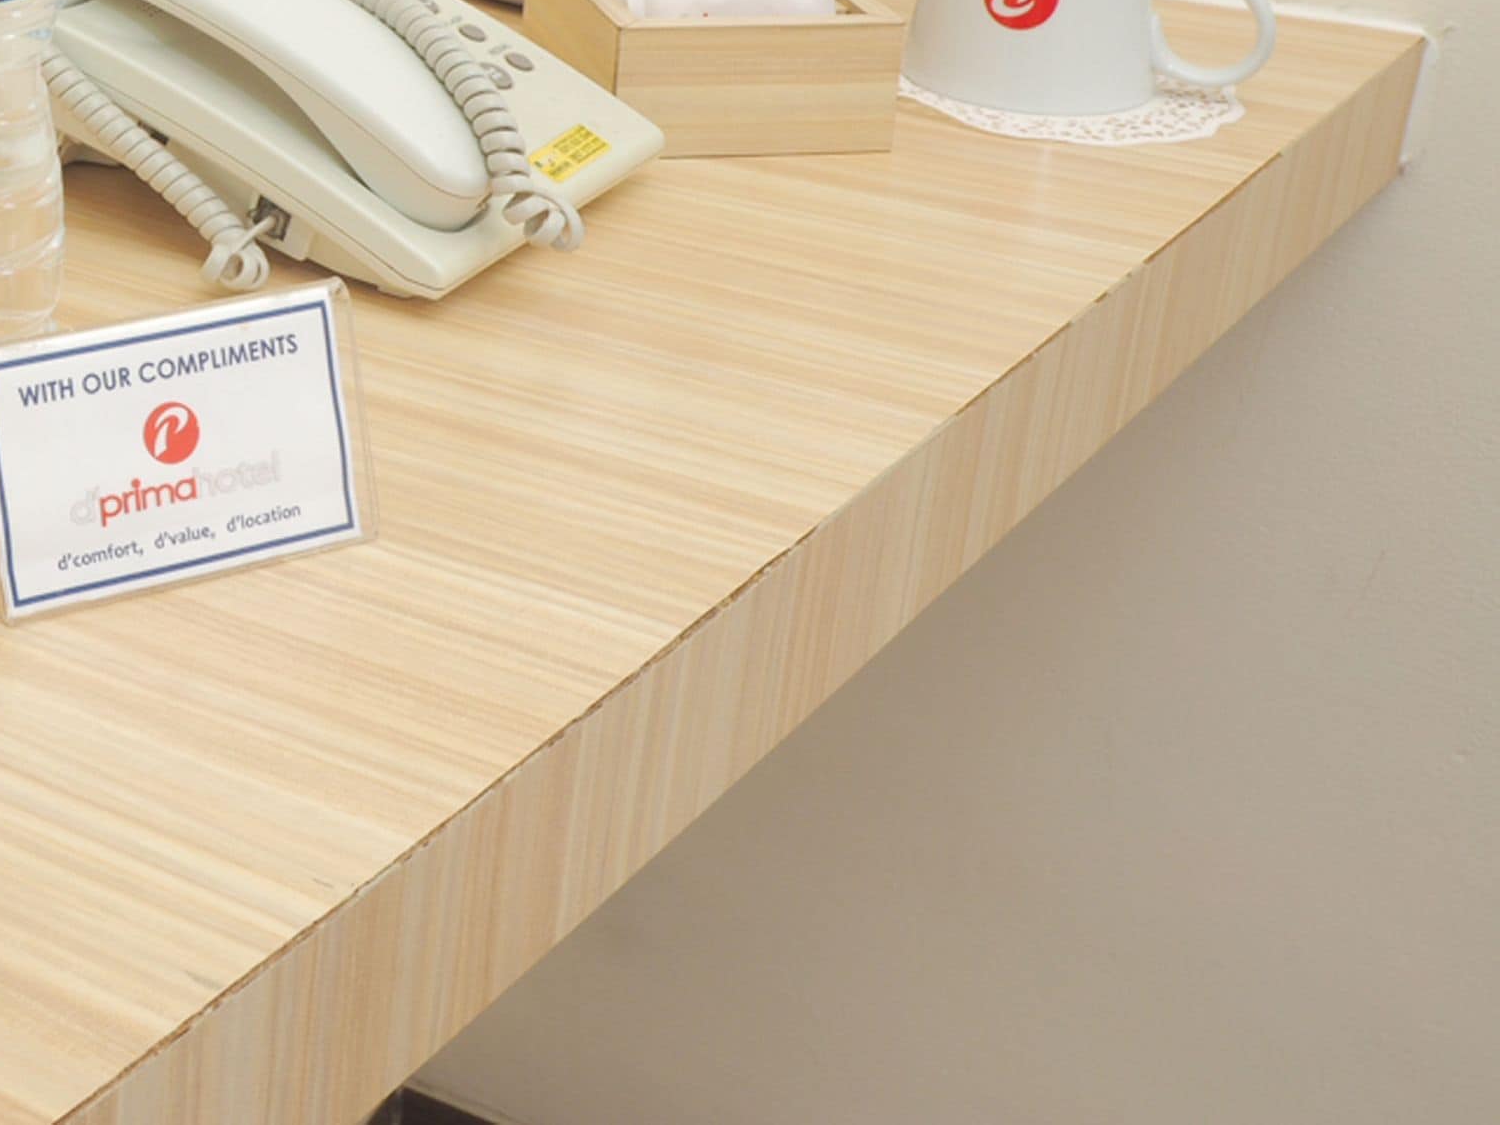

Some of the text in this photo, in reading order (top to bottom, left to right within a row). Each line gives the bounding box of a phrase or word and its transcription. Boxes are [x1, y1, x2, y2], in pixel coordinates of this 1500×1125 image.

[18, 333, 299, 407] WITH OUR COMPLIMENTS
[57, 503, 302, 571] d'comfort, d'value, d'location
